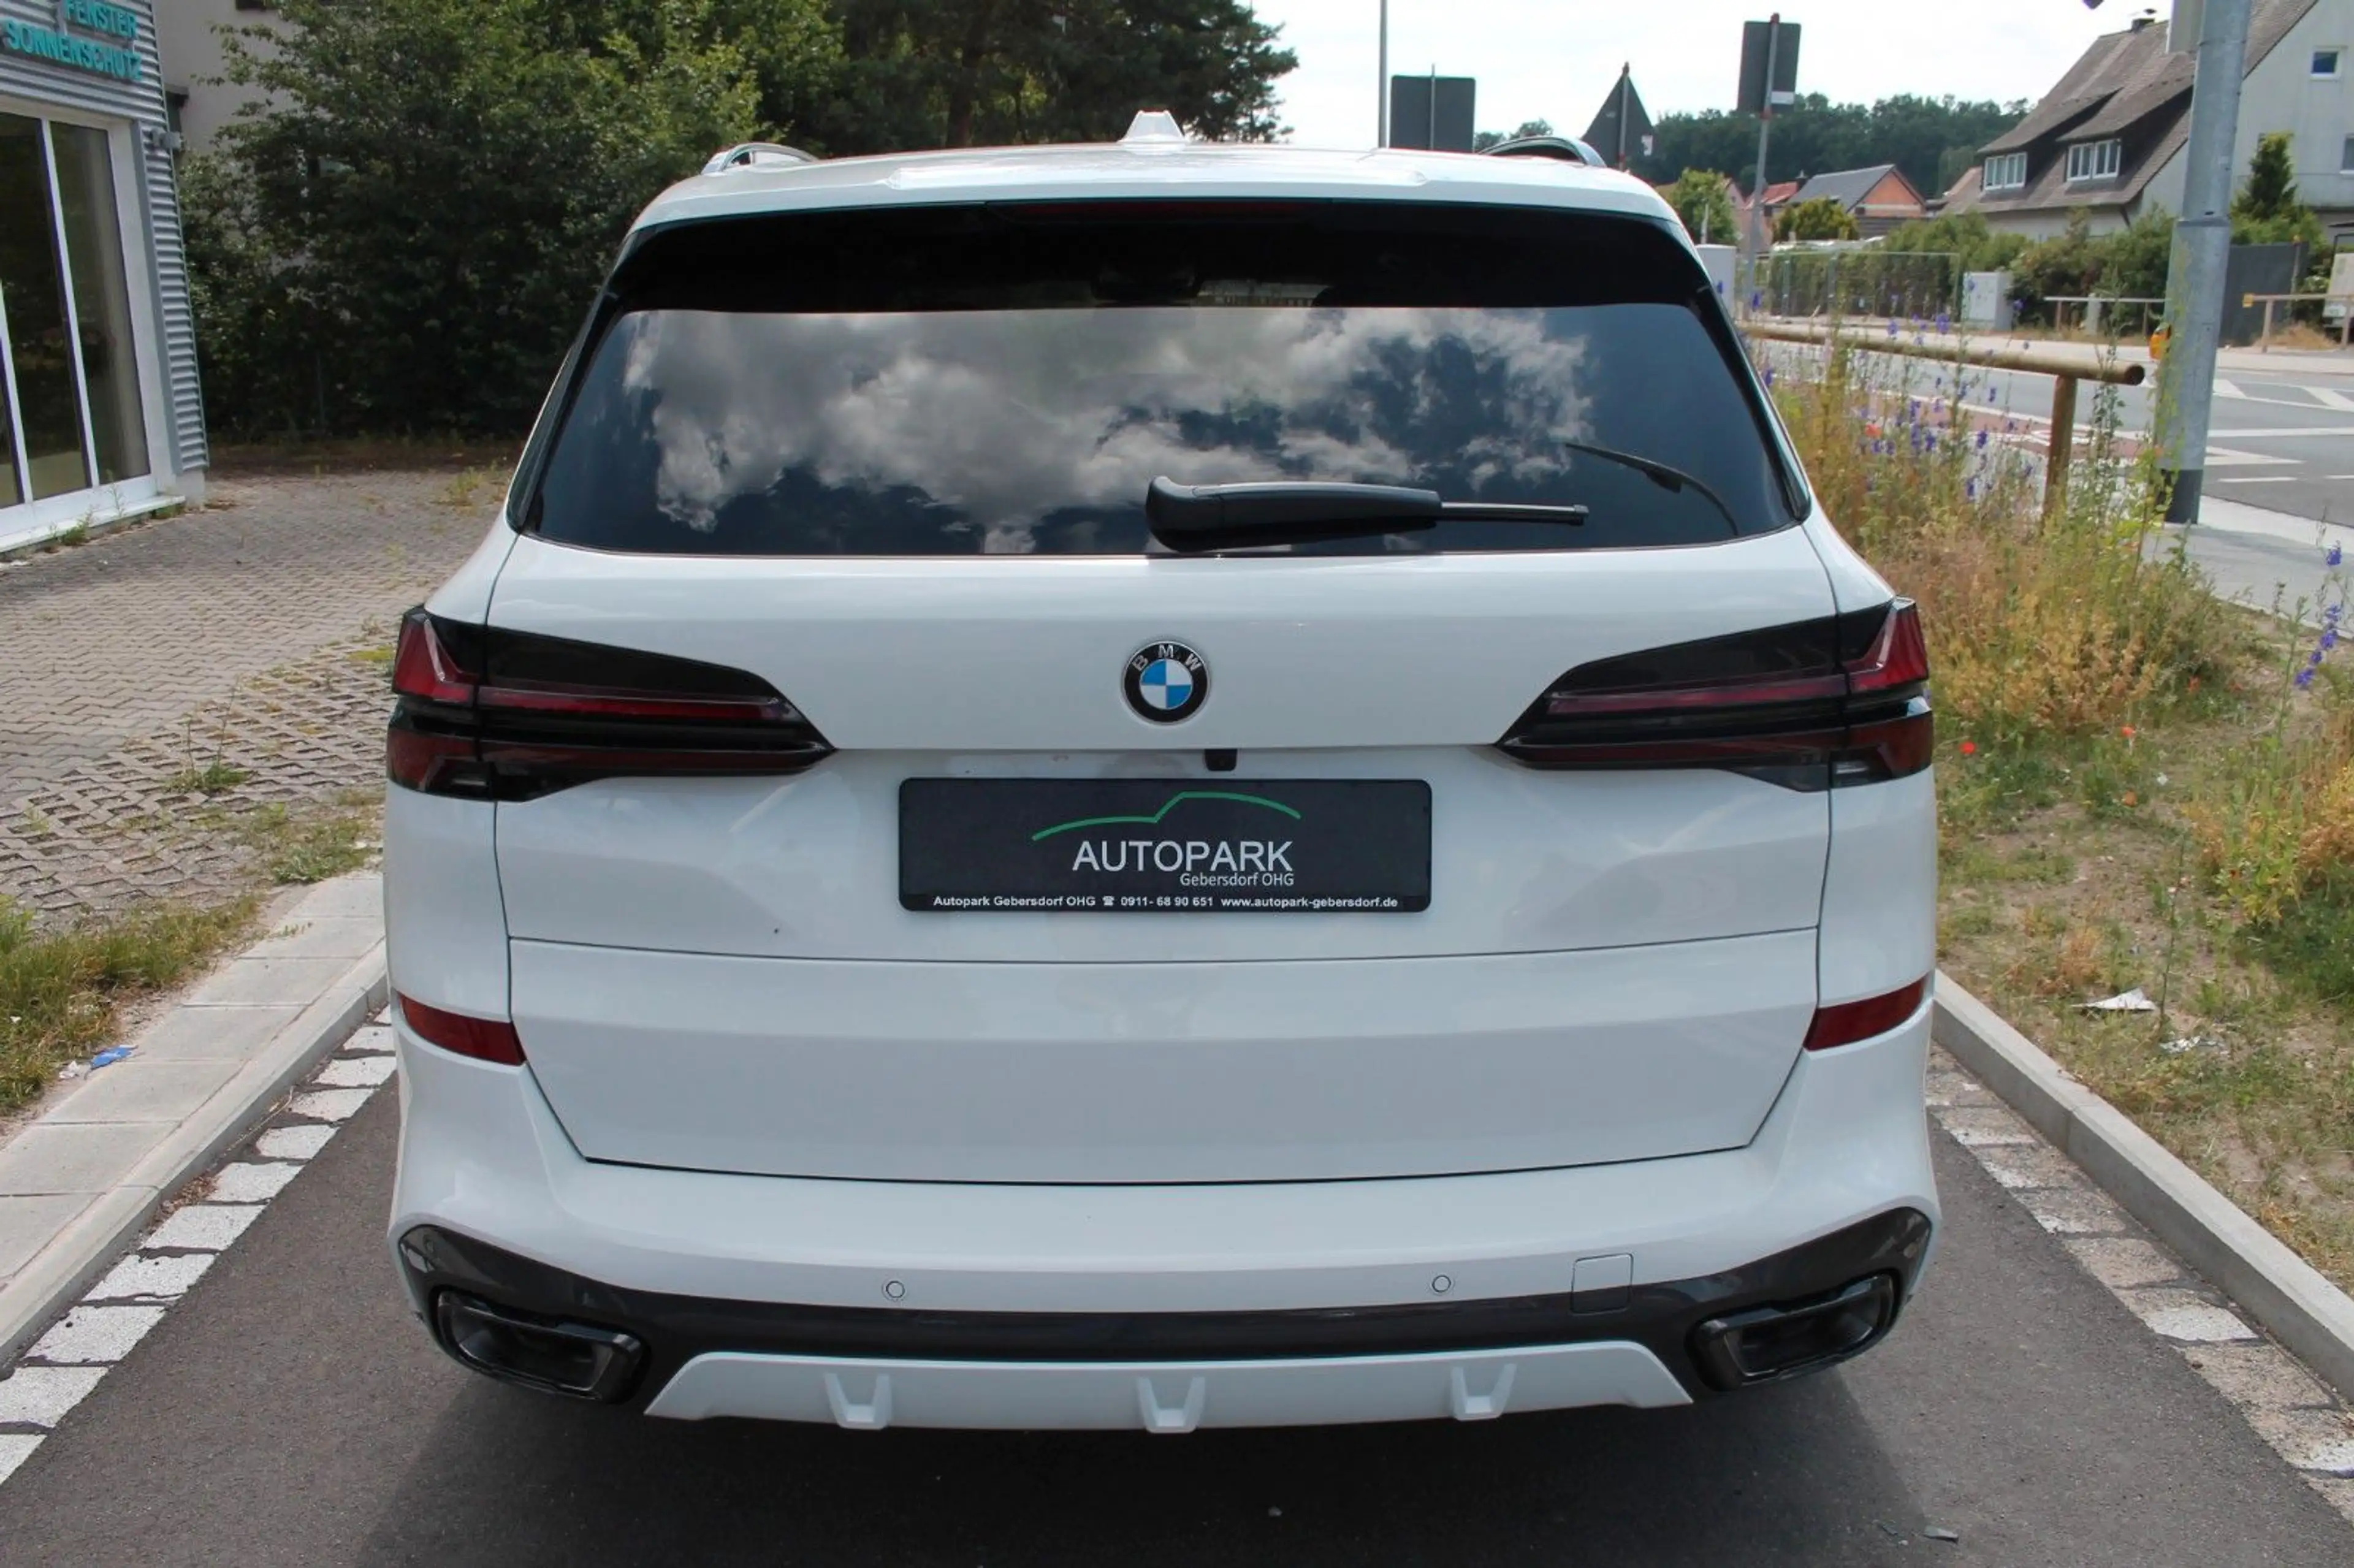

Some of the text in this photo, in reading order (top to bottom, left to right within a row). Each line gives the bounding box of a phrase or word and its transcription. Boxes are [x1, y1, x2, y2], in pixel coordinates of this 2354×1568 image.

[65, 0, 137, 39] FENSTER
[2, 18, 142, 81] SONNENSCHUTZ
[1132, 644, 1202, 671] BMW
[1072, 840, 1293, 872] AUTOPARK
[1179, 872, 1295, 886] Gebersdorf OHG
[933, 896, 990, 908] Autopark
[993, 896, 1064, 907] Gebersdorf
[1066, 896, 1096, 907] OHG
[1156, 896, 1171, 907] 68
[1174, 896, 1189, 907] 90
[1192, 896, 1214, 907] 651
[1221, 896, 1398, 909] www.autopark-gebersdorf.de
